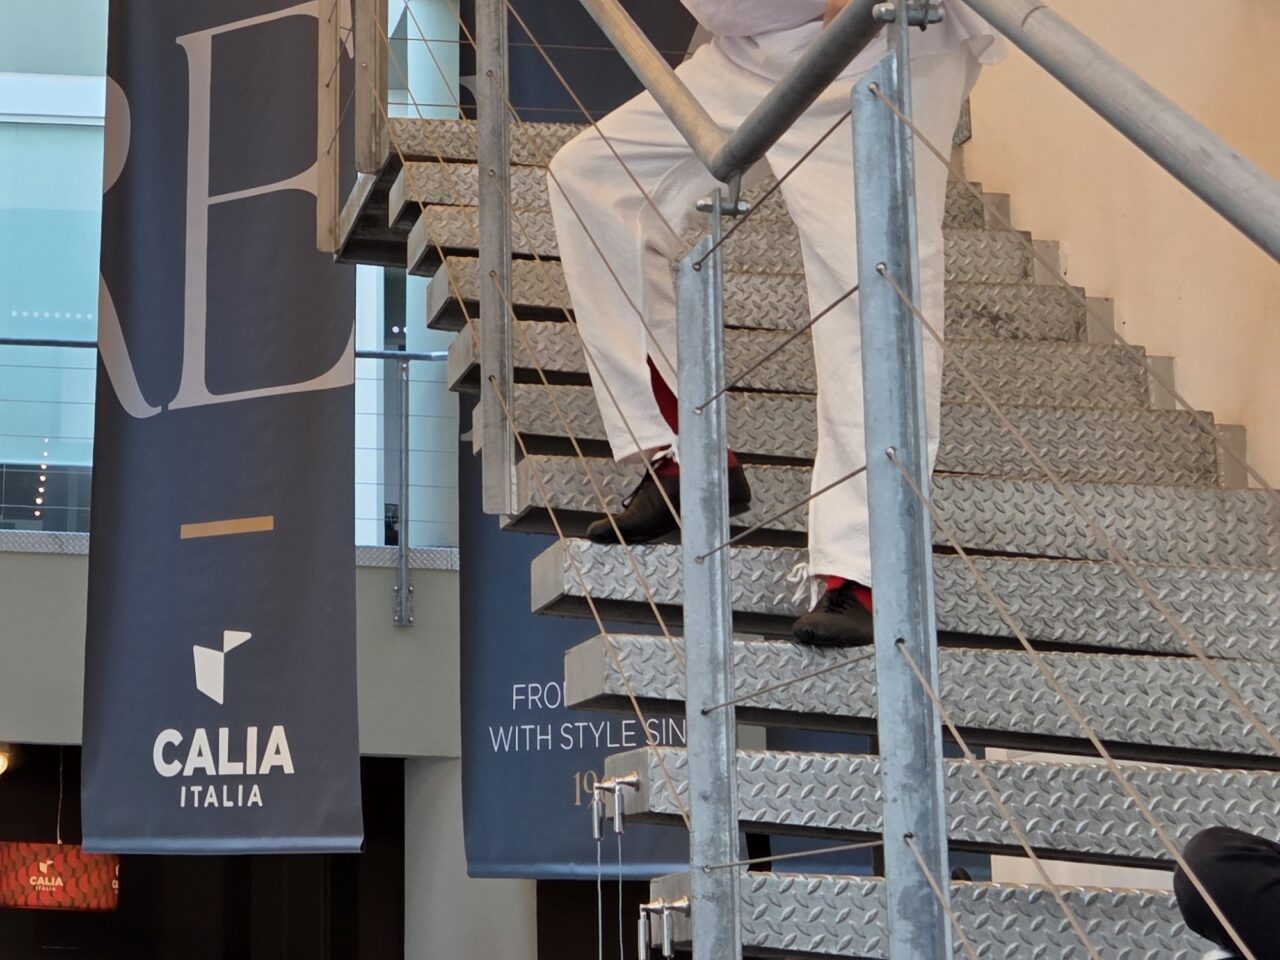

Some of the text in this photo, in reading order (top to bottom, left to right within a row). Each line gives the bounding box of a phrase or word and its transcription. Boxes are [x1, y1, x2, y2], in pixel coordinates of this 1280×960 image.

[512, 681, 566, 710] FRO
[153, 725, 295, 777] CALIA
[489, 718, 687, 753] WITH STYLE SIN
[180, 784, 263, 808] ITALIA
[573, 770, 599, 806] 19
[29, 876, 64, 887] CALIA
